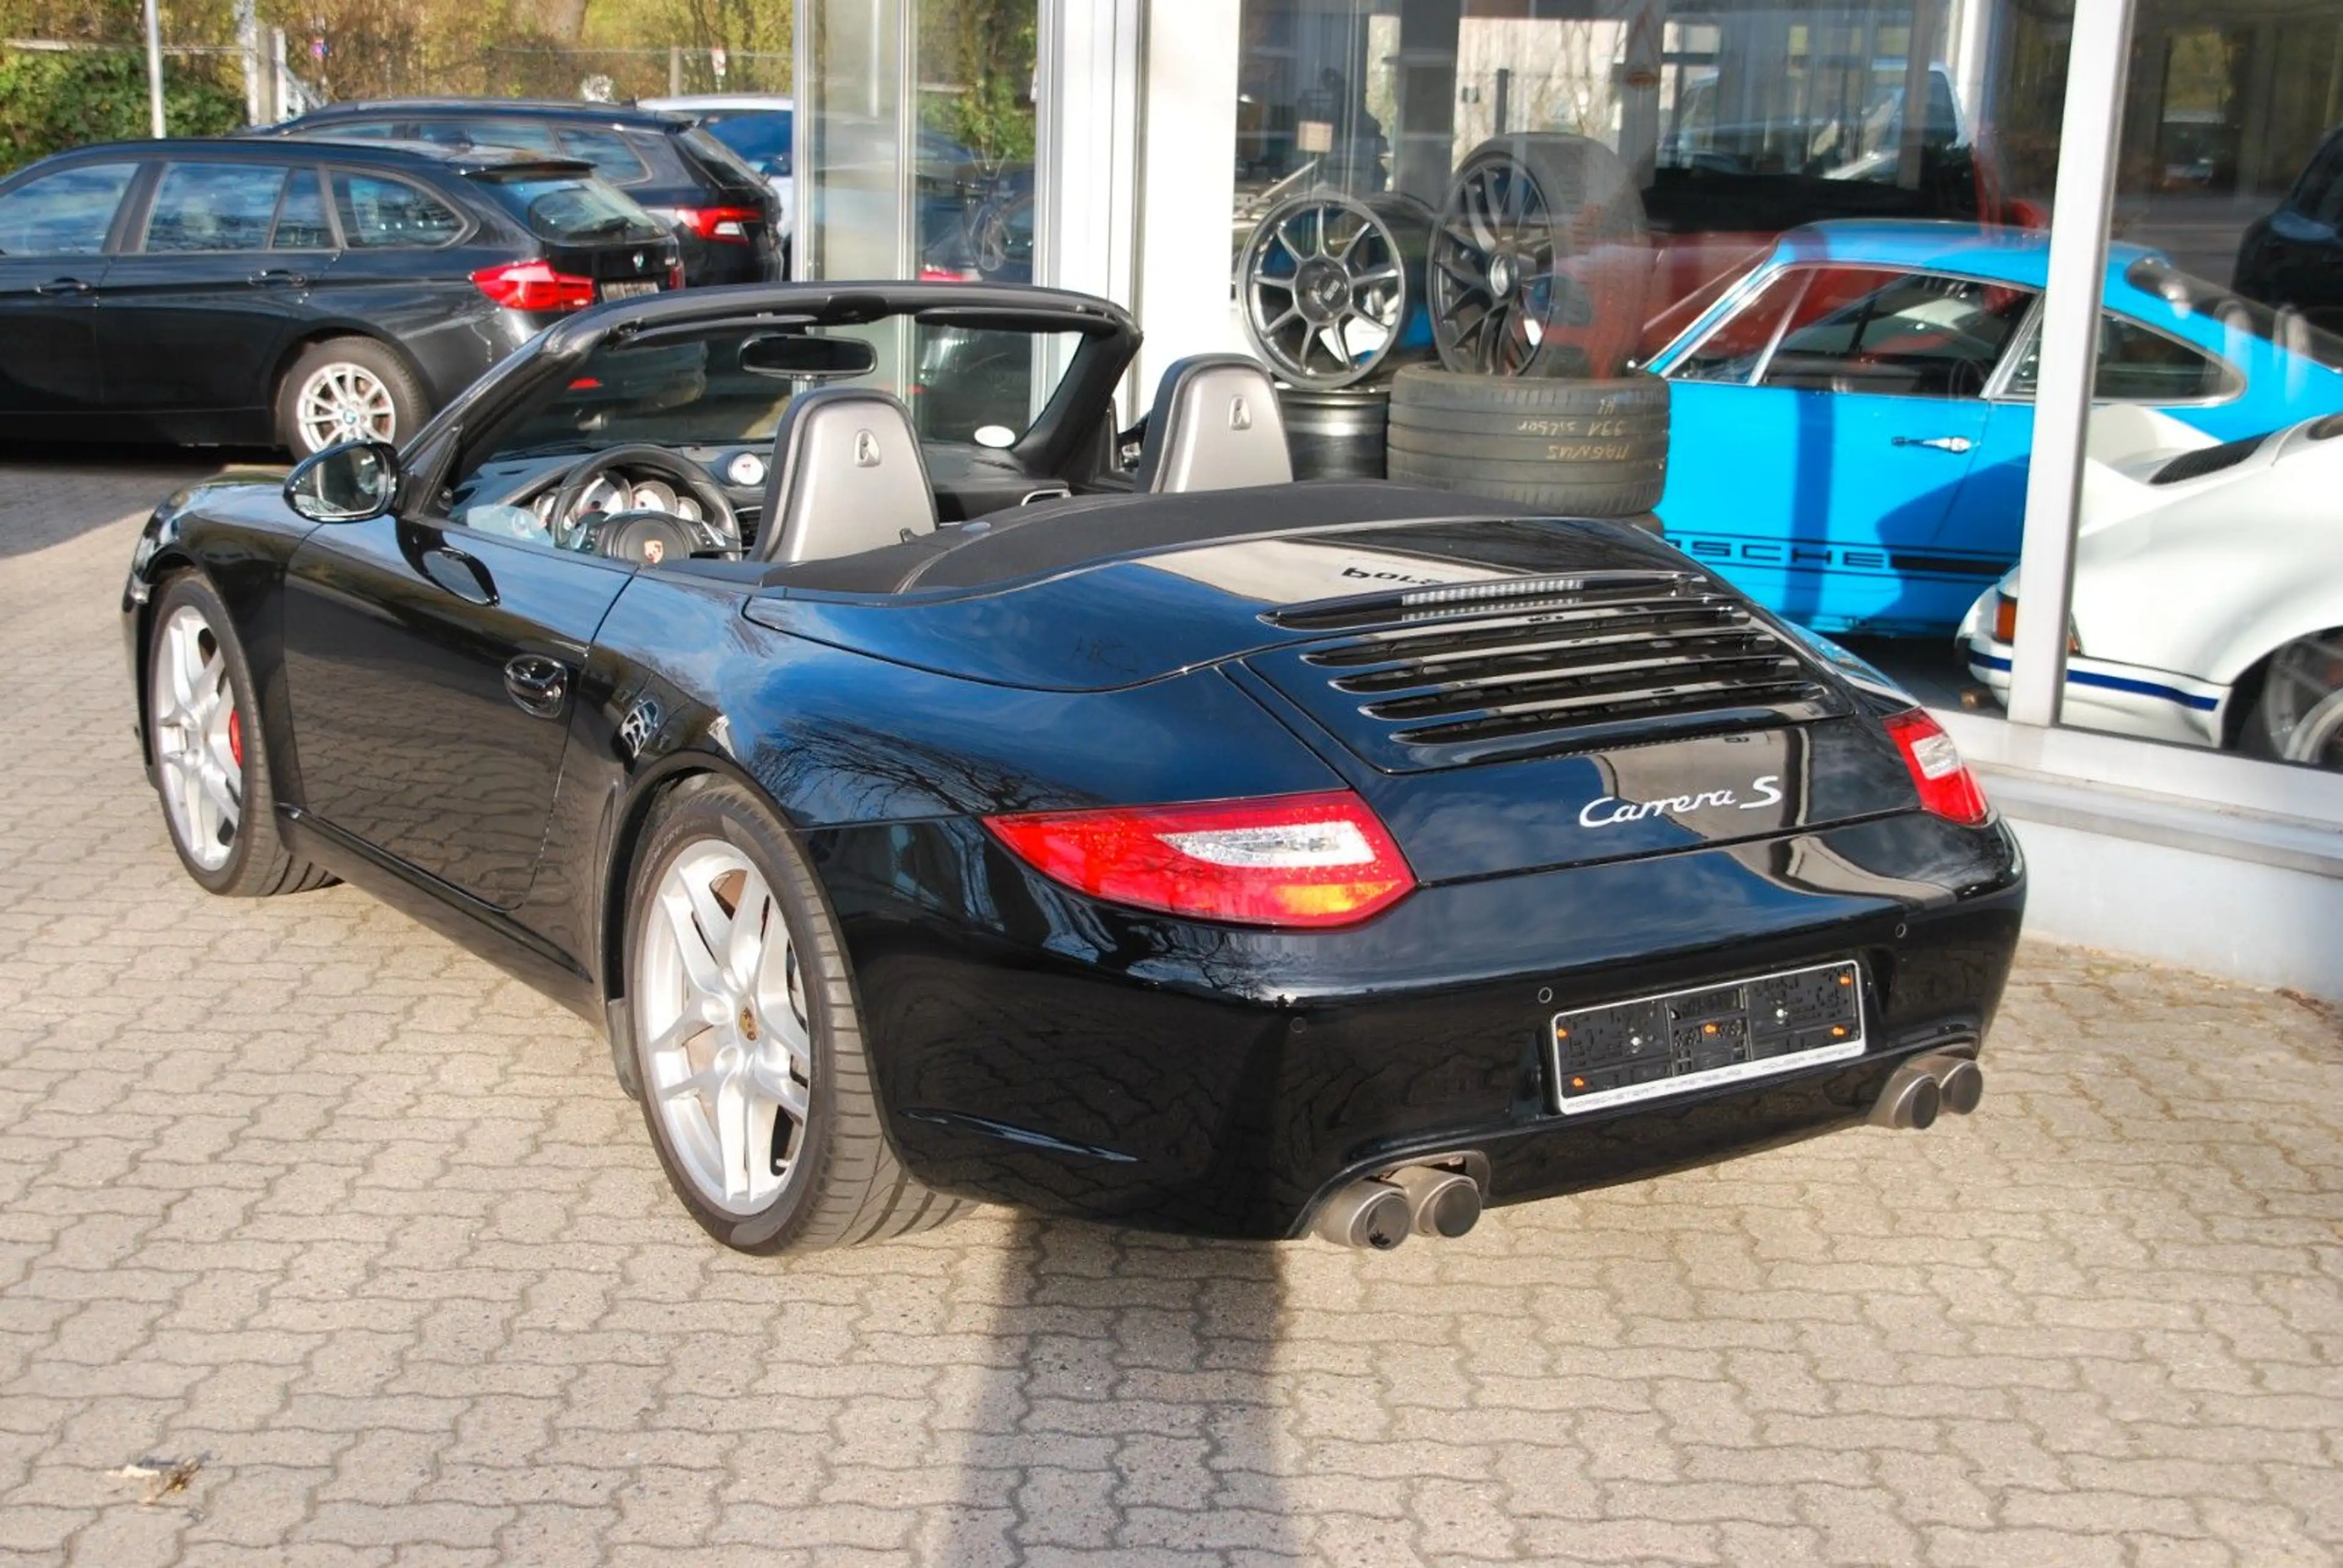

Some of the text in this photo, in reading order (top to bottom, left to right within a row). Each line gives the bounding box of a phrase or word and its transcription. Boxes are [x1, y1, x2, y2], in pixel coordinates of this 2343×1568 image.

[1665, 539, 1884, 569] SCHE
[1579, 775, 1782, 828] Carrera S
